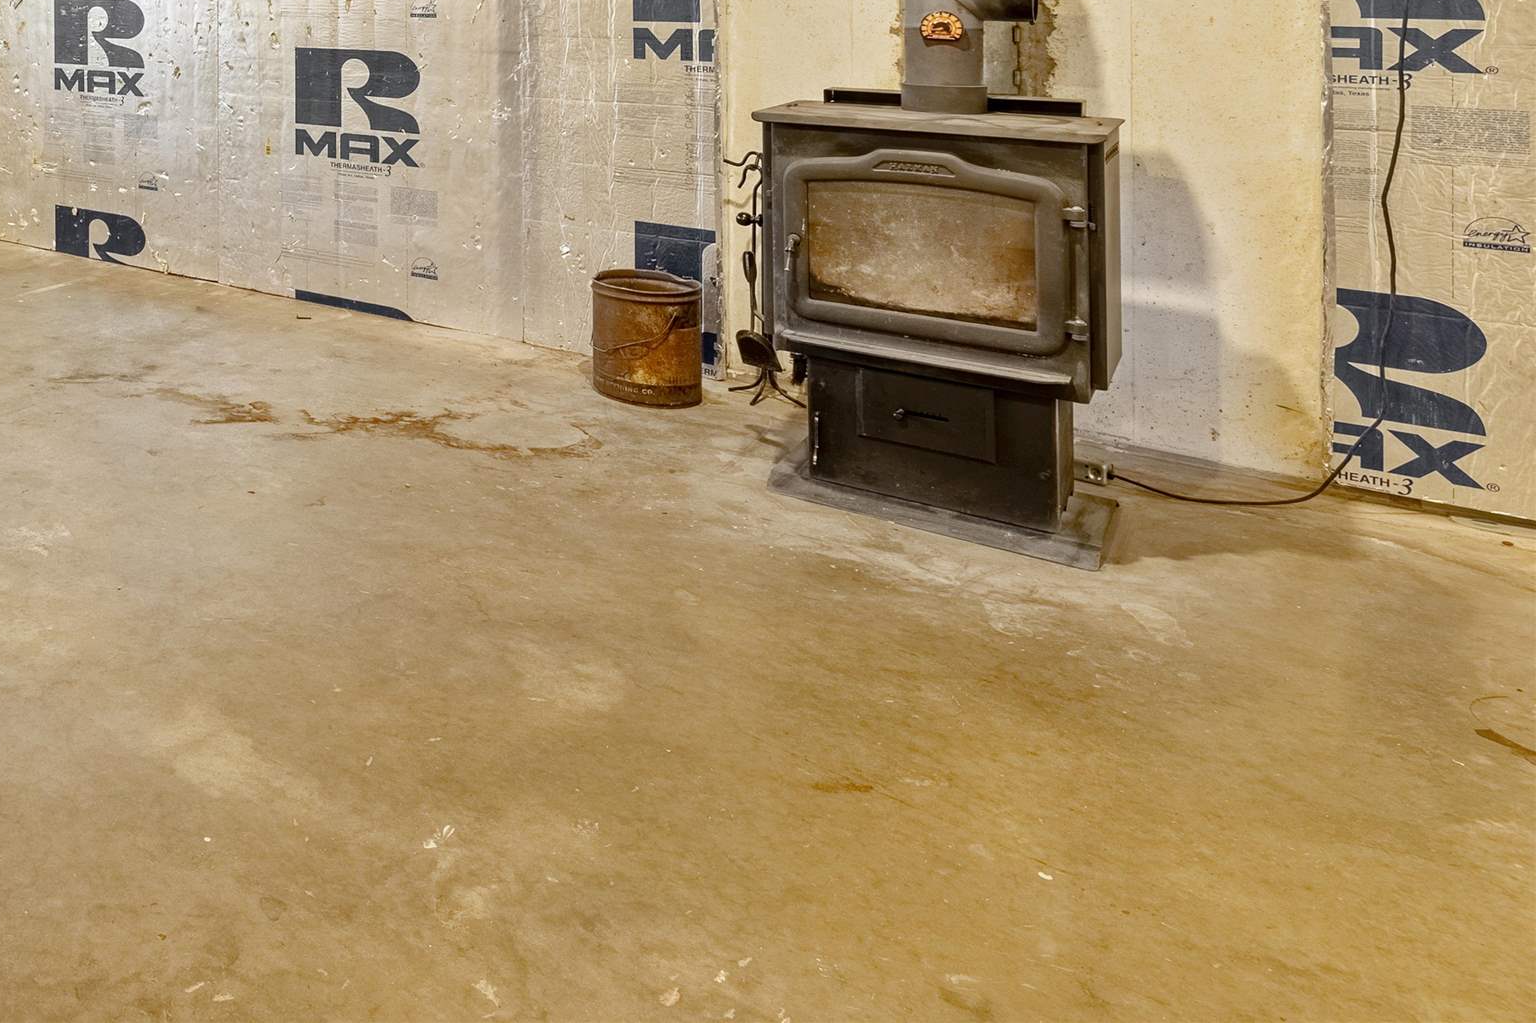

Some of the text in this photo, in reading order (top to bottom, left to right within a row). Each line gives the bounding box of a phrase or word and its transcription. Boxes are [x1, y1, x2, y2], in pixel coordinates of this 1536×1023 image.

[54, 68, 145, 97] MAX
[295, 48, 420, 134] R
[295, 128, 420, 168] MAX
[330, 162, 392, 177] THERMASHEATH-3
[1463, 240, 1530, 253] INSULATION
